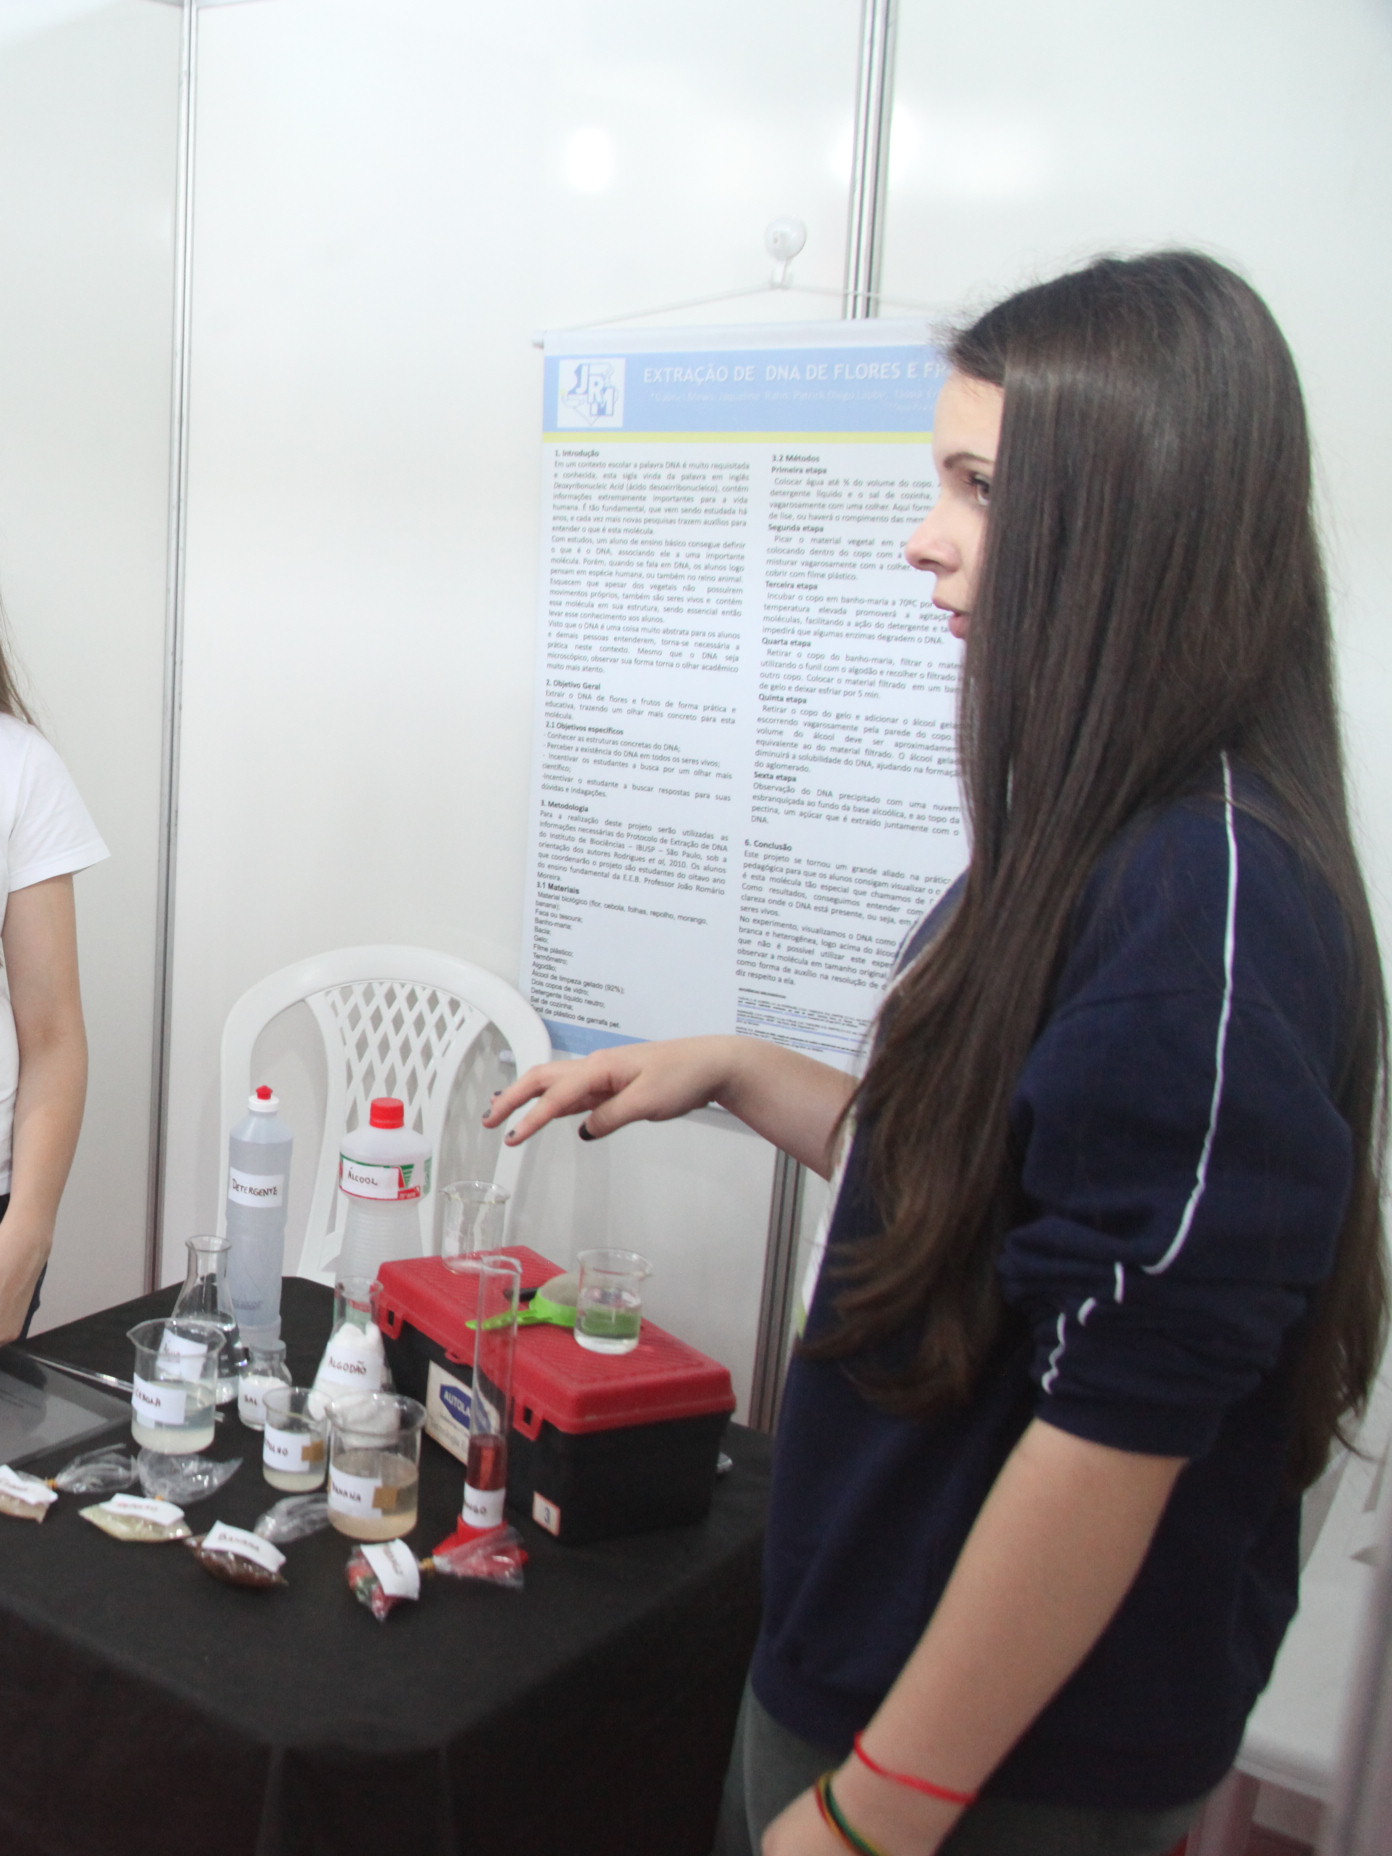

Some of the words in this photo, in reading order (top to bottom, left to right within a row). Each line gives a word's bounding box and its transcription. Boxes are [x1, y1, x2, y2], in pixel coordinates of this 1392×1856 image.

[644, 364, 728, 386] EXTRAÇÃO
[734, 366, 755, 381] DE
[766, 365, 801, 381] DNA
[806, 364, 828, 380] DE
[834, 362, 901, 380] FLORES
[907, 362, 918, 378] E
[562, 449, 599, 458] Introdução
[785, 453, 819, 462] Métodos
[771, 465, 803, 473] Primeira
[805, 466, 827, 476] etapa
[768, 523, 800, 533] Segunda
[802, 524, 824, 534] etapa
[765, 580, 794, 588] Terceira
[796, 582, 817, 591] etapa
[761, 636, 788, 646] Quarta
[789, 638, 811, 648] etapa
[553, 679, 580, 689] Objetivo
[582, 681, 600, 689] Geral
[758, 693, 784, 703] Quinta
[785, 695, 806, 705] etapa
[545, 720, 554, 728] 2.1
[556, 721, 586, 732] Objetivos
[587, 726, 623, 735] específicos
[754, 770, 773, 780] Sexta
[775, 773, 796, 783] etapa
[547, 800, 588, 813] Metodologia
[753, 839, 792, 850] Conclusão
[536, 880, 545, 889] 3.1
[547, 882, 579, 894] Materiais
[348, 1167, 378, 1186] ÁLCOOL
[232, 1178, 278, 1196] DETERGENTE
[329, 1356, 367, 1375] ALGODÃO
[545, 1507, 551, 1524] 3
